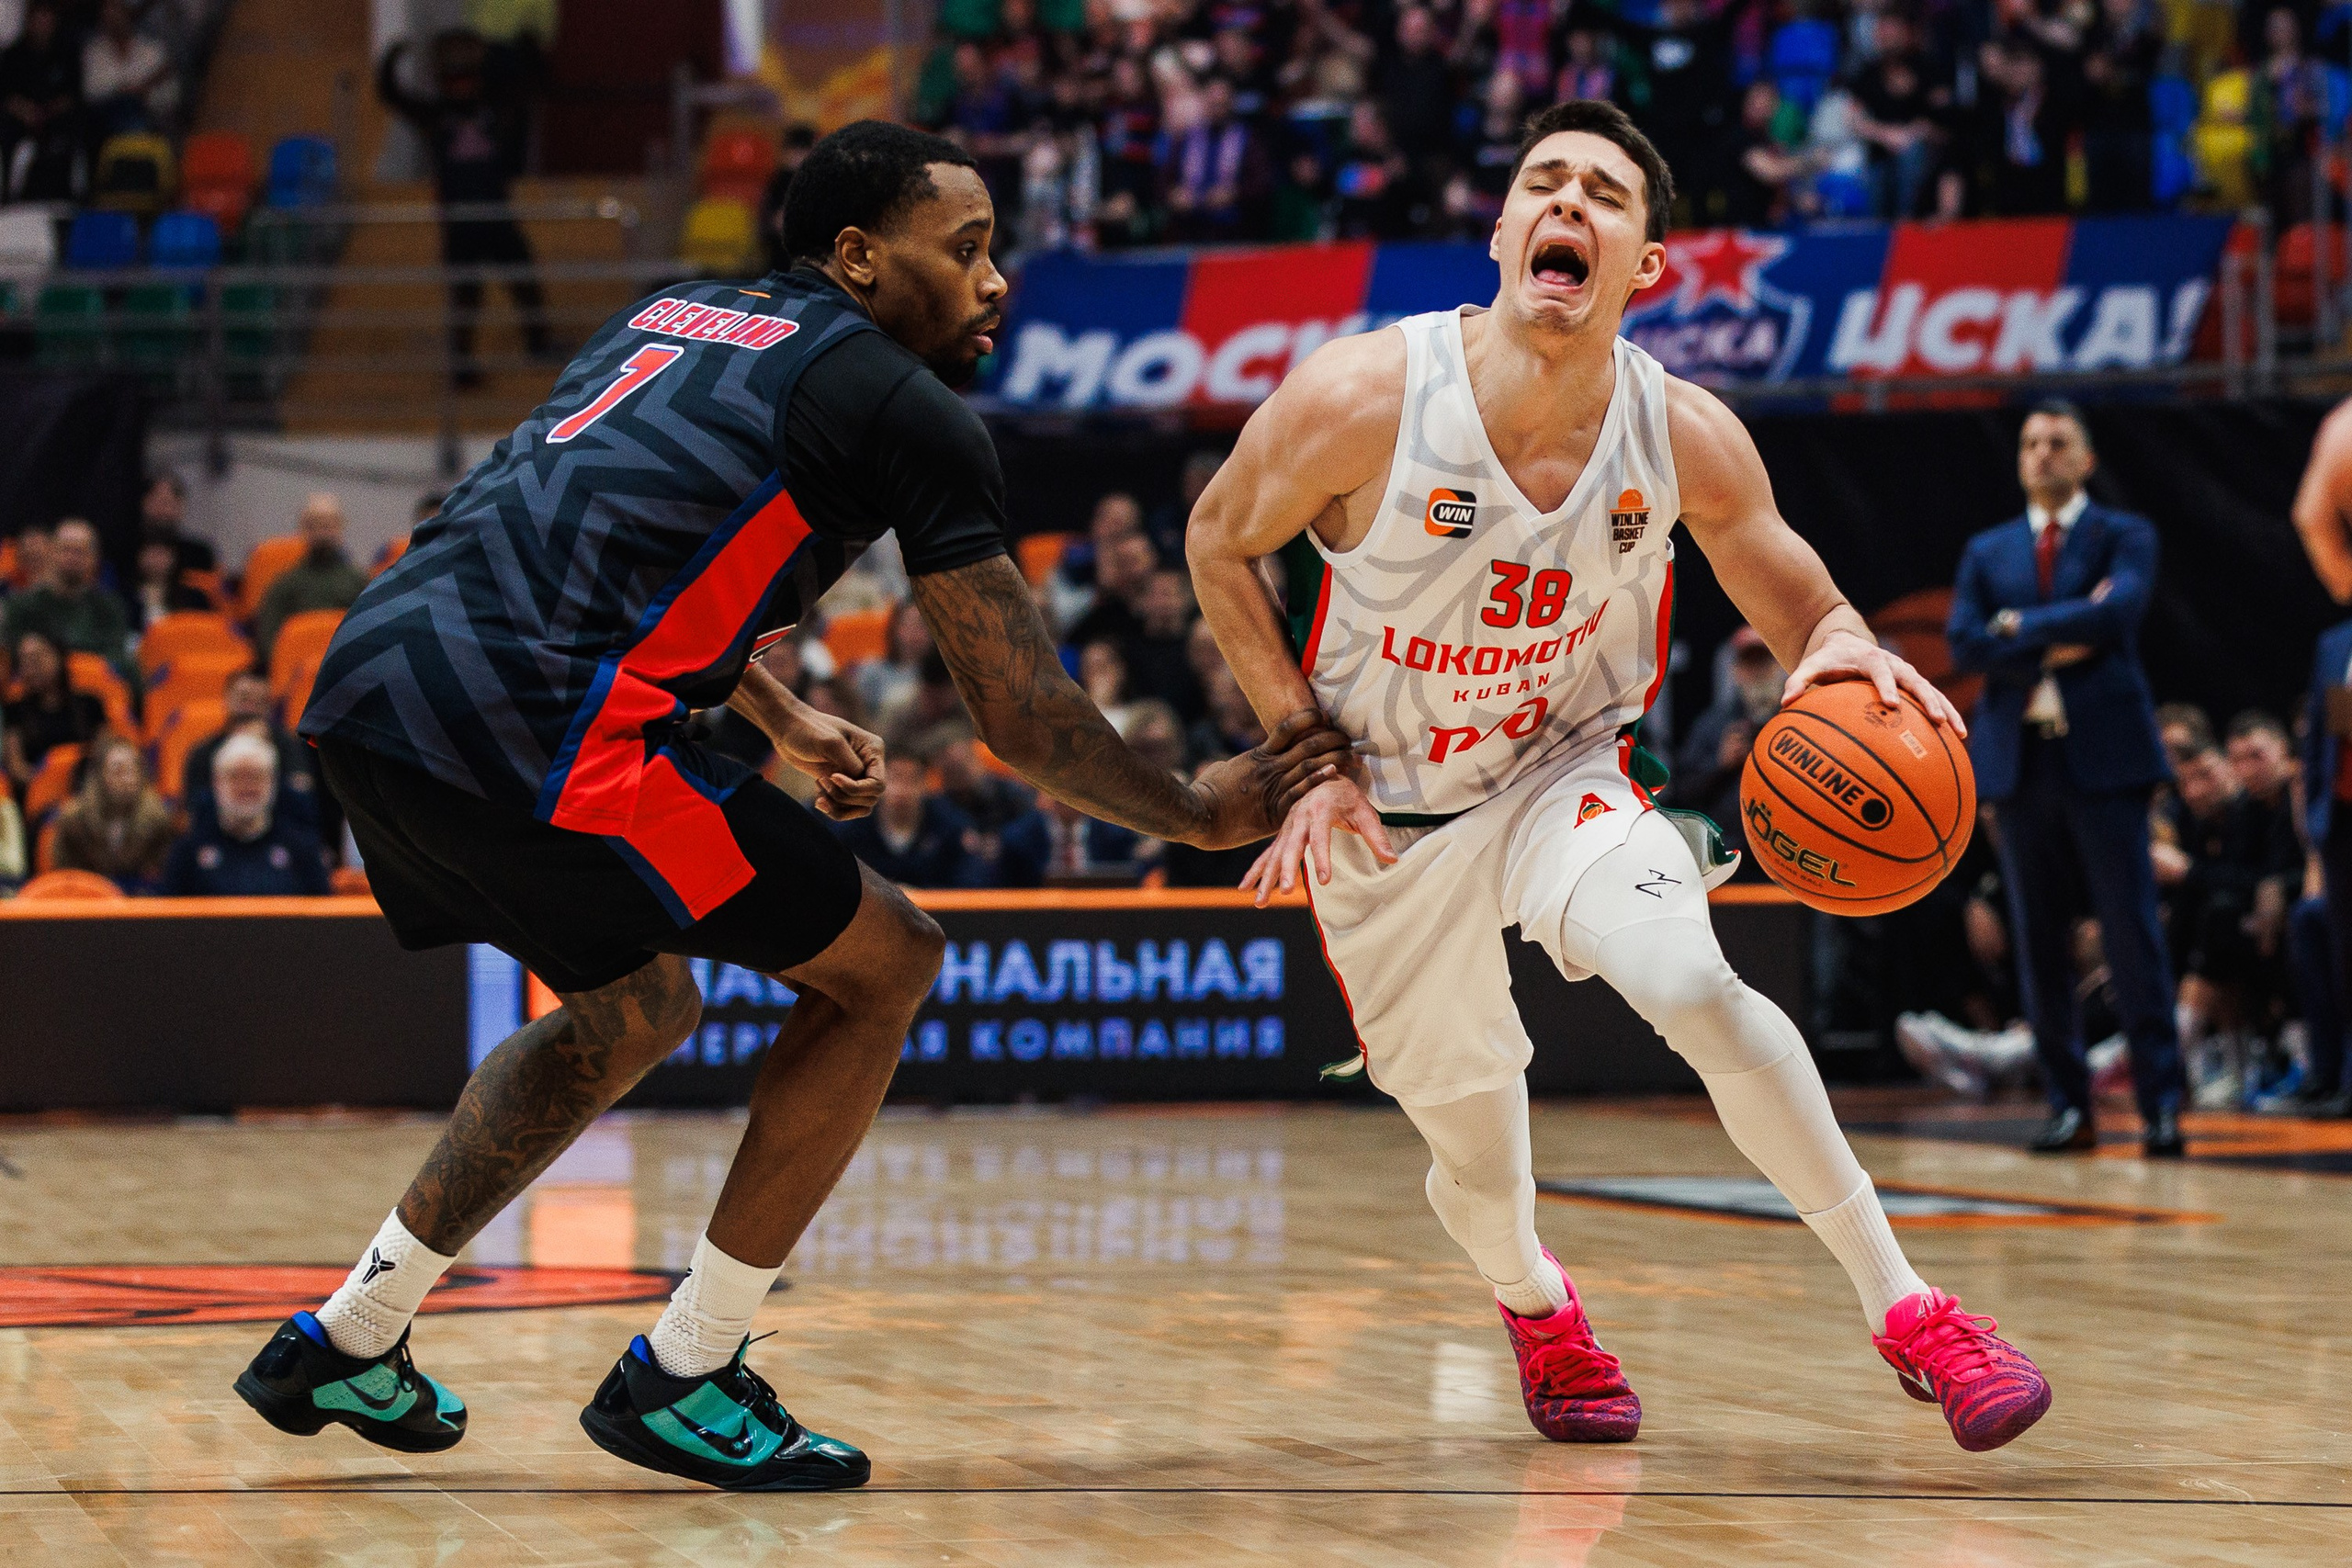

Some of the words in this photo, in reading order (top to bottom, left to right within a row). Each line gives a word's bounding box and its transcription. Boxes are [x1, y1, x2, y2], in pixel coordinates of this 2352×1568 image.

[628, 298, 800, 351] CLEVELAND
[1824, 276, 2211, 371] ЦСКА!
[546, 343, 684, 444] 1
[1439, 506, 1473, 522] WIN
[1611, 512, 1649, 527] WINLINE
[1613, 526, 1645, 541] BASKET
[1619, 541, 1635, 554] CUP
[1480, 558, 1573, 629] 38
[1381, 598, 1611, 676] LOKOMOTIV
[1453, 672, 1550, 703] KUBAN
[1774, 733, 1865, 807] WINLINE
[1742, 797, 1857, 887] JÖGEL
[970, 1016, 1286, 1062] КОМПАНИЯ
